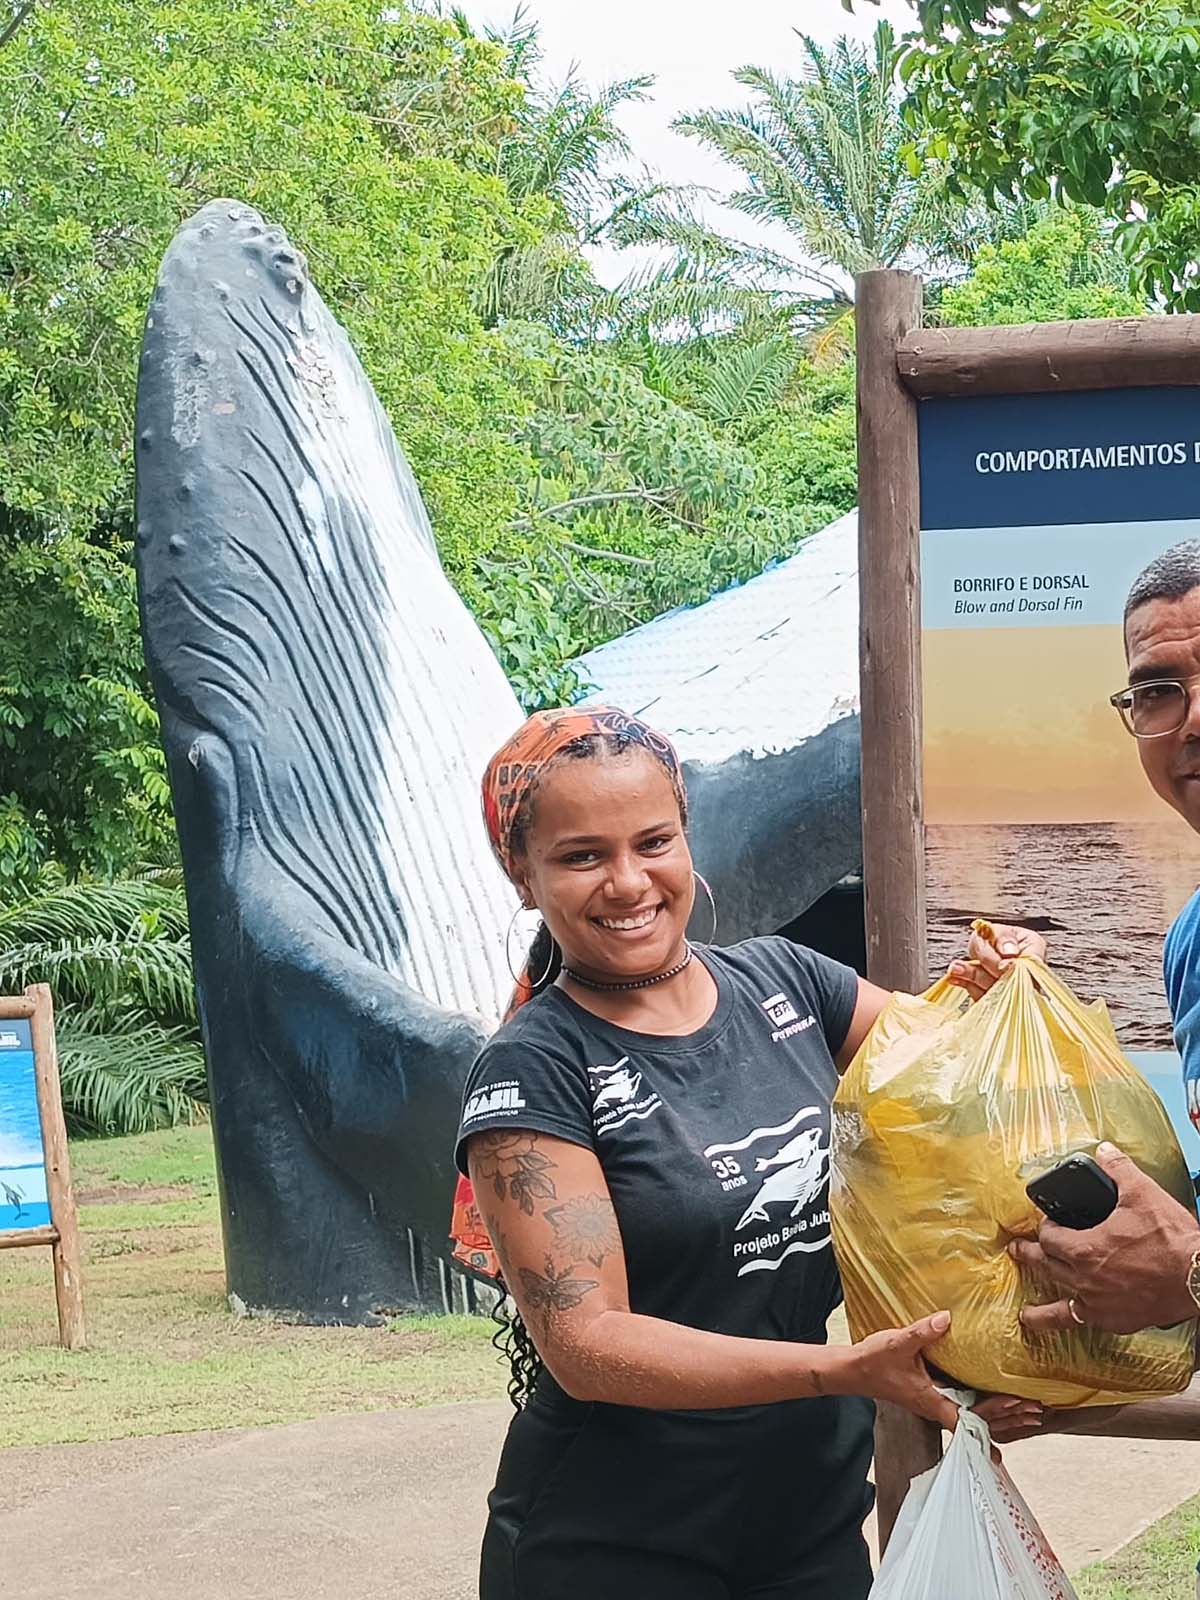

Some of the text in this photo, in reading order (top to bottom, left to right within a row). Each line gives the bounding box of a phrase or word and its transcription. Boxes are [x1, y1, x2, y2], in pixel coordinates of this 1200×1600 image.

[975, 441, 1187, 474] COMPORTAMENTOS
[954, 575, 1090, 592] BORRIFO E DORSAL
[954, 596, 1083, 613] Blow and Dorsal Fin
[711, 1155, 741, 1178] 35
[721, 1175, 748, 1192] anos
[733, 1233, 780, 1257] Projeto
[809, 1210, 830, 1228] Jub
